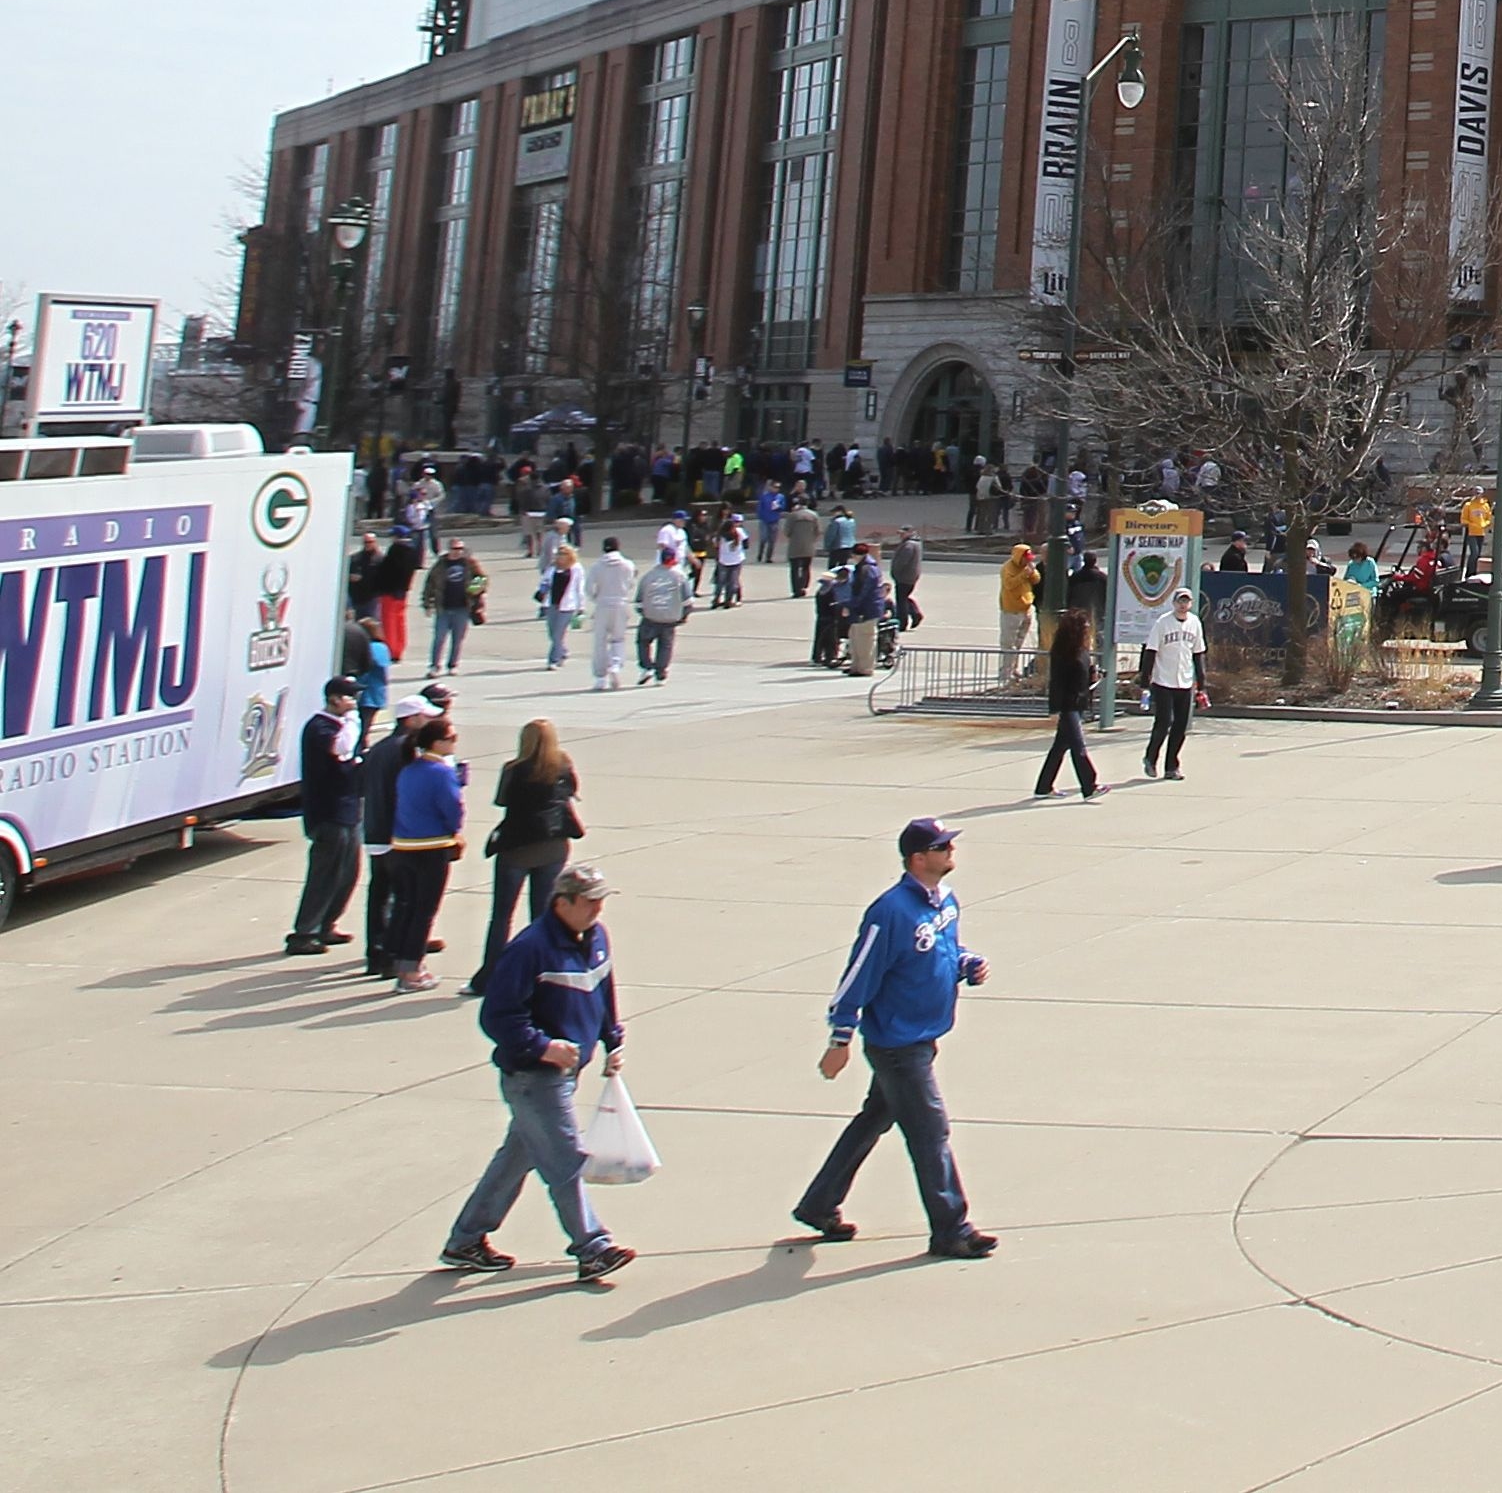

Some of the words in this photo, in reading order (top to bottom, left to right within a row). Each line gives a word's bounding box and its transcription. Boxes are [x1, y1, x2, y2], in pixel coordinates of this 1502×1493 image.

[1062, 19, 1080, 66] 8
[1043, 79, 1081, 179] BRAUN
[1457, 62, 1489, 157] DAVIS
[81, 322, 118, 360] 620
[66, 363, 125, 401] WTMJ
[19, 514, 193, 551] RADIO
[1125, 520, 1179, 531] Directory
[88, 727, 193, 774] STATION
